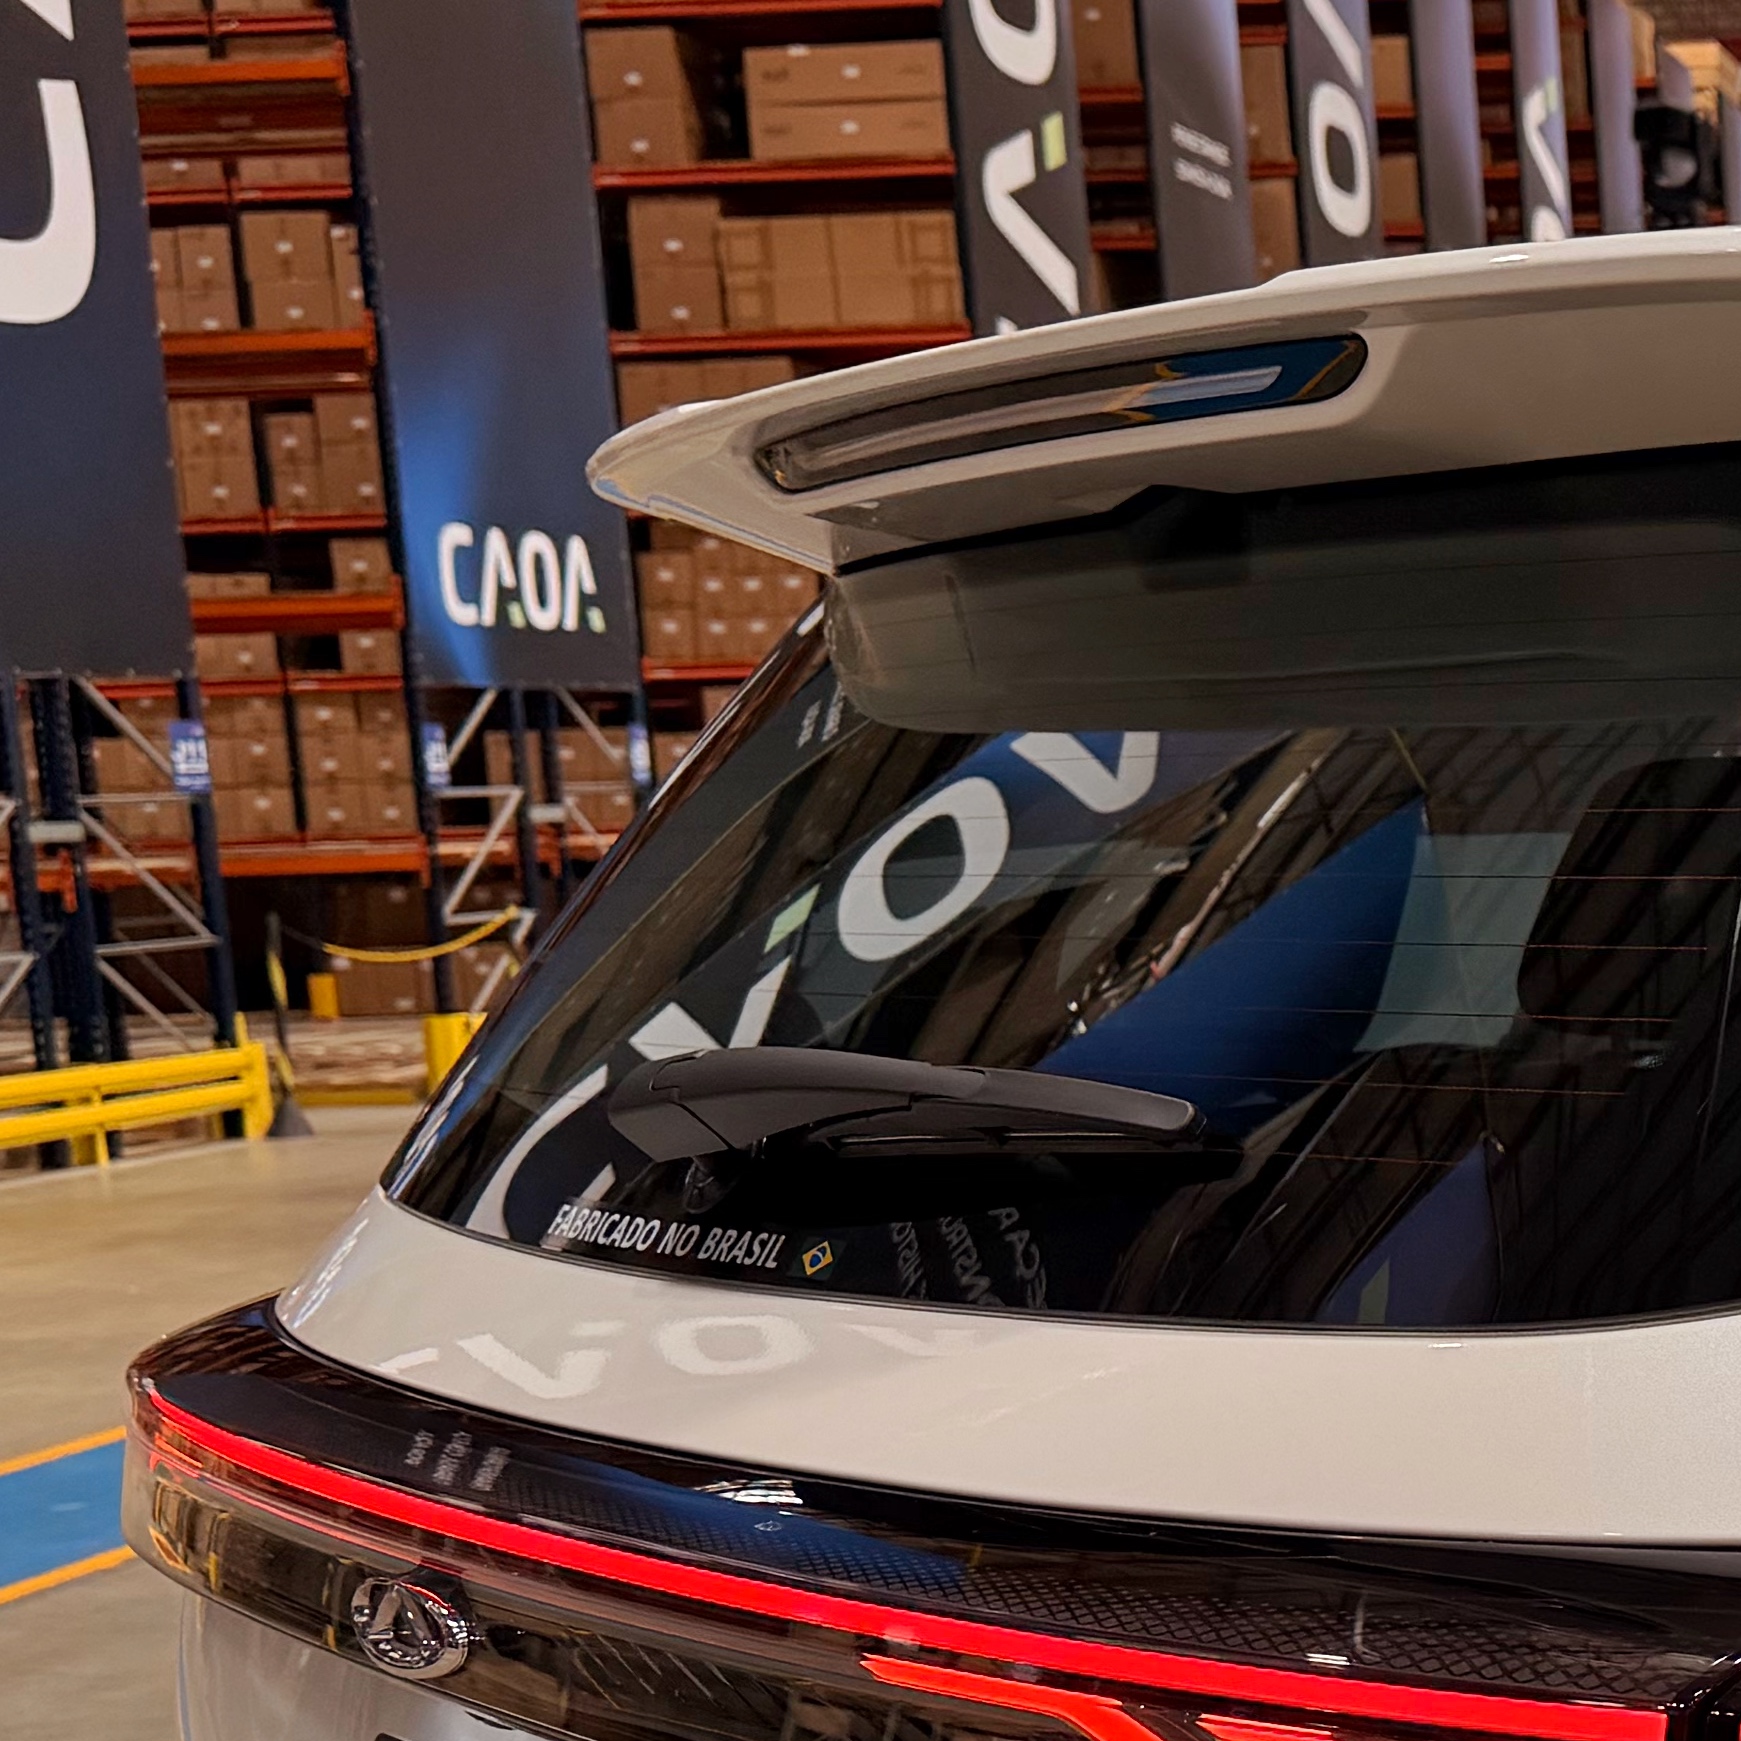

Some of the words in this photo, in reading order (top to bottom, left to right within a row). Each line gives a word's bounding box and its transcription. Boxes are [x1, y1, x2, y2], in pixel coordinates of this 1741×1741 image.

[438, 521, 606, 633] CAOA
[548, 1204, 661, 1252] FABRICADO
[656, 1222, 700, 1257] NO
[698, 1228, 785, 1269] BRASIL
